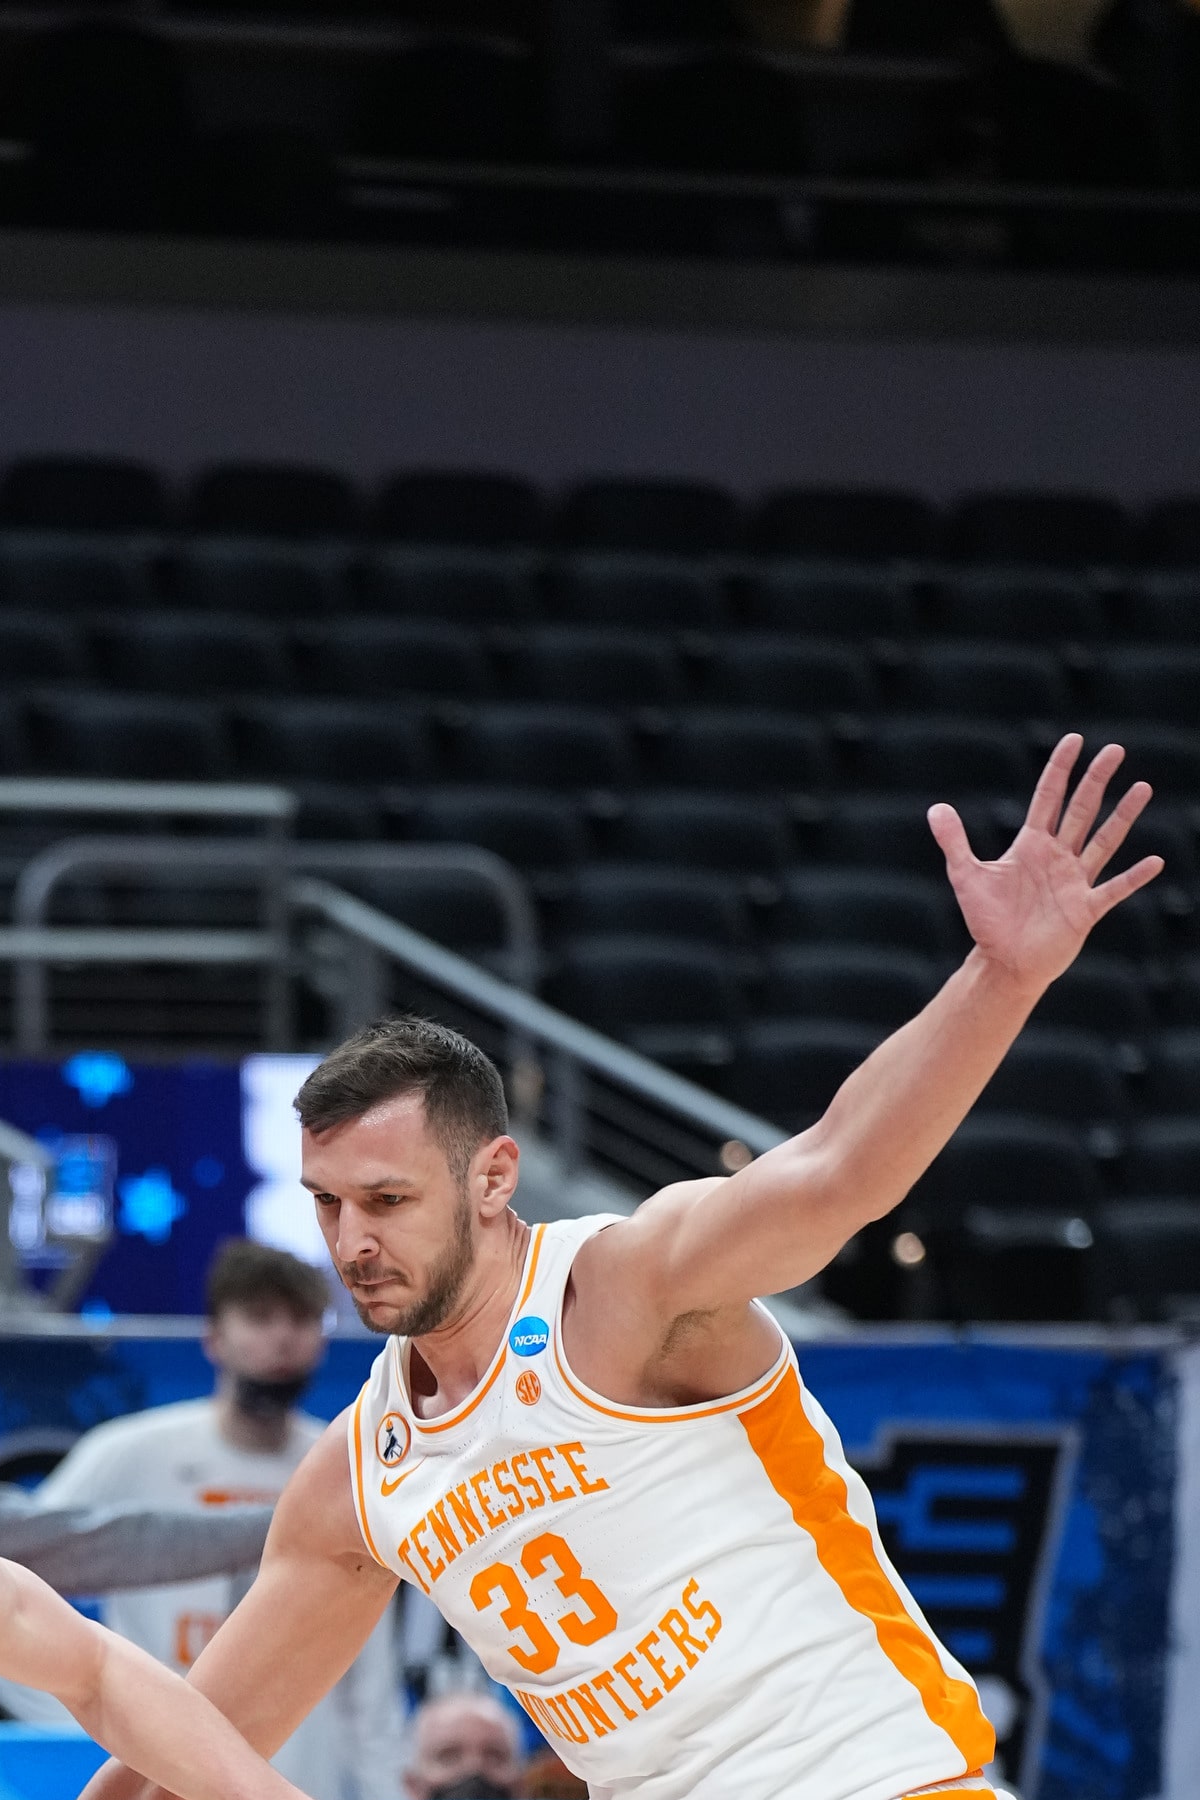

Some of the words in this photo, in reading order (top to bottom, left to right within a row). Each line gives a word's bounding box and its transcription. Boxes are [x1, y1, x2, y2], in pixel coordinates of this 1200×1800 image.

[514, 1333, 548, 1347] NCAA
[517, 1373, 540, 1403] SEC
[397, 1441, 611, 1595] TENNESSEE
[469, 1531, 619, 1675] 33
